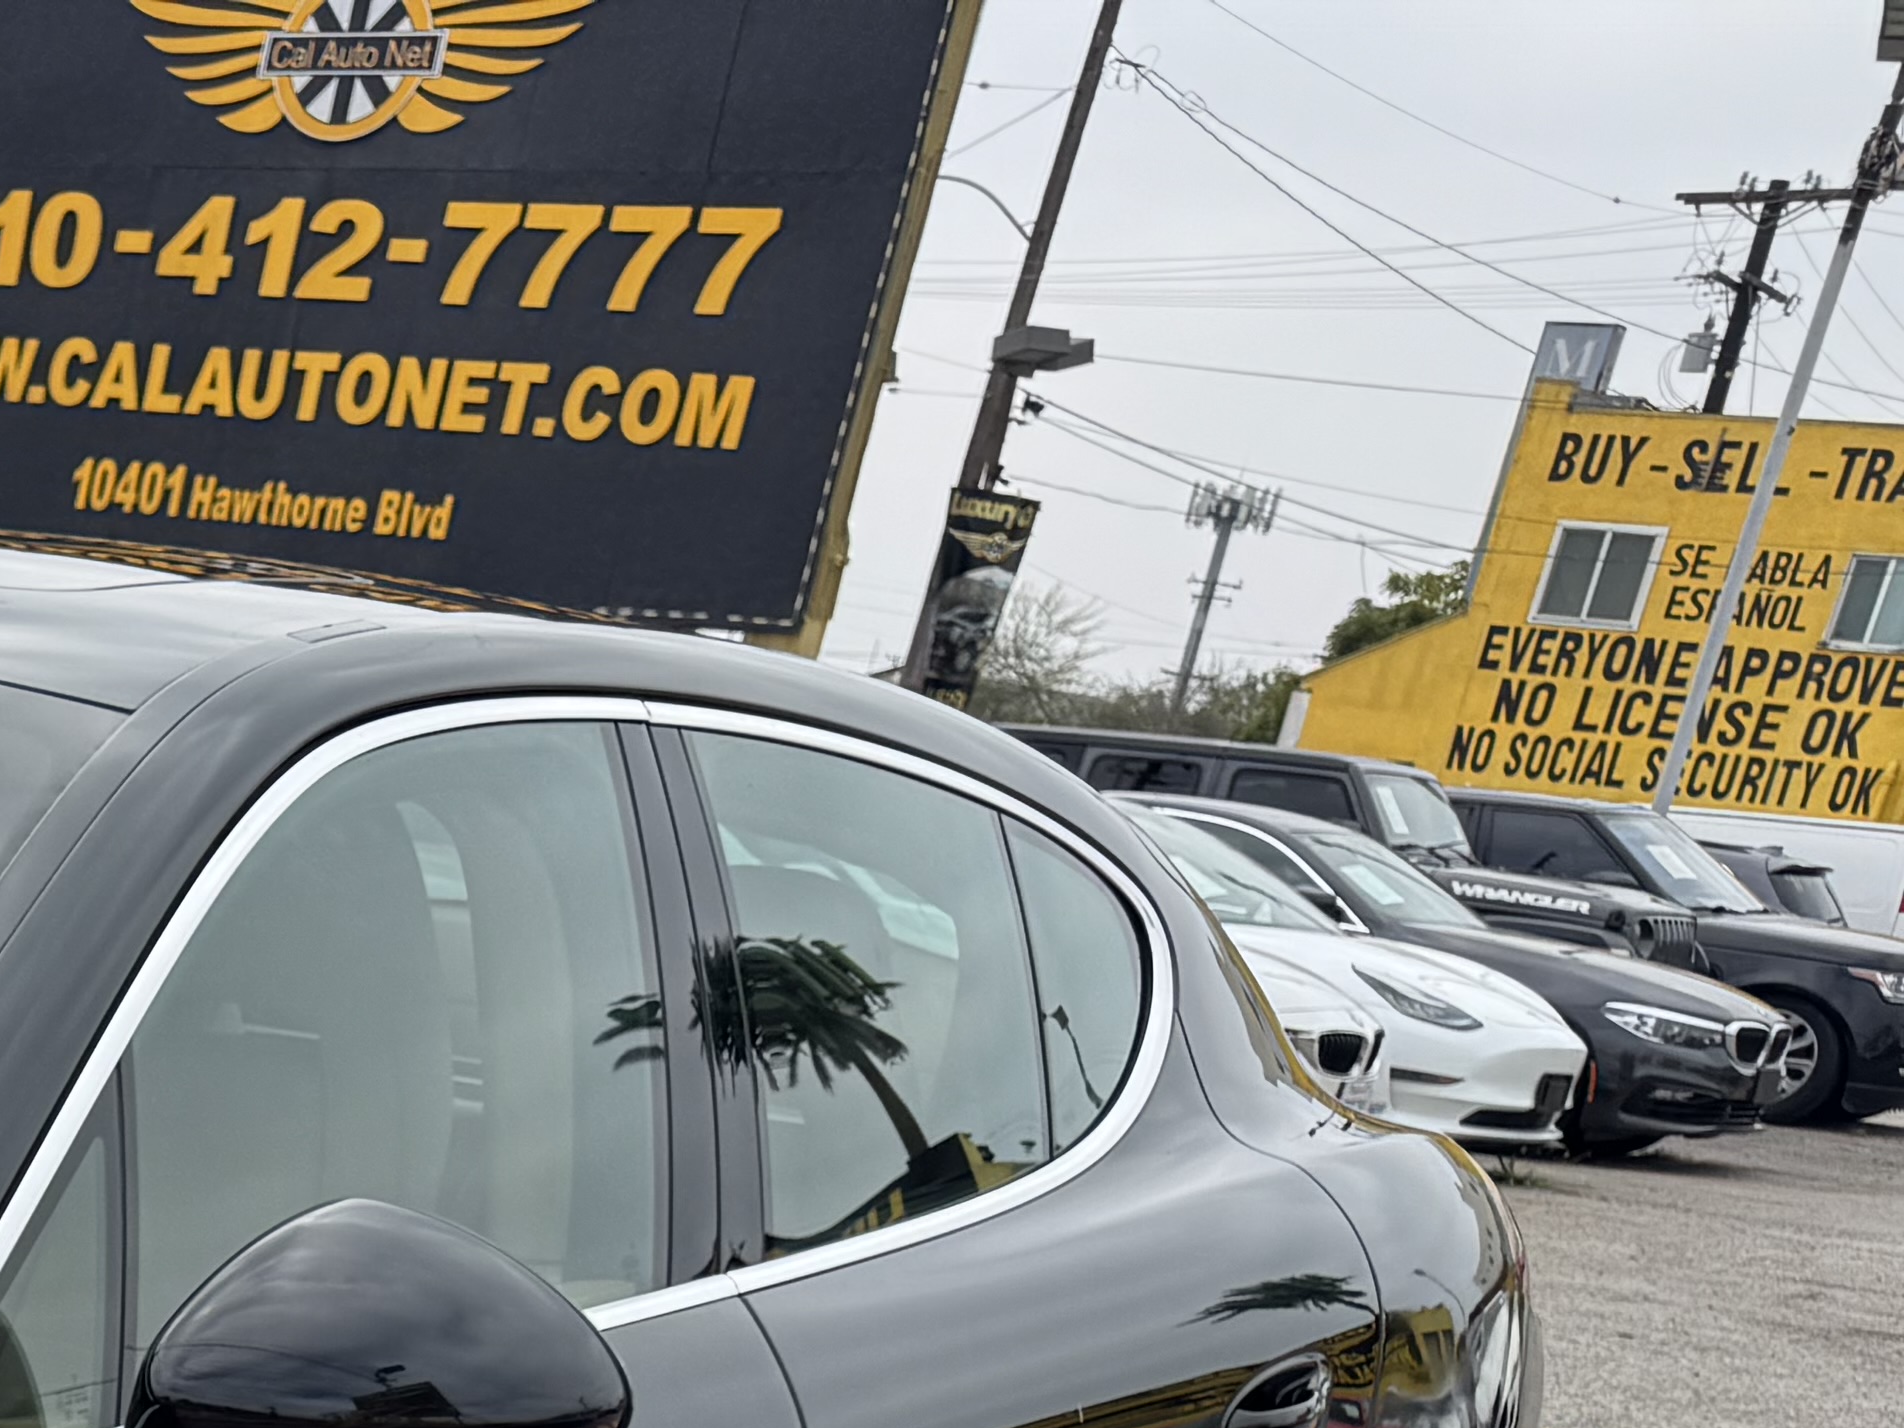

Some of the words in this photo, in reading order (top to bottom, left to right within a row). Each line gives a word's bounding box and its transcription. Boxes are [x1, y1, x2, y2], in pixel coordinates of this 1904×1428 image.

[271, 39, 315, 69] Cal
[317, 38, 380, 69] Auto
[384, 38, 434, 68] Net
[71, 455, 189, 519] 10401
[187, 472, 368, 533] Hawthorne
[373, 488, 455, 541] Blvd
[1668, 543, 1717, 580] SE
[1742, 549, 1833, 590] ABLA
[1477, 624, 1700, 689] EVERYONE
[1710, 644, 1904, 709] APPROVE
[1491, 677, 1558, 727] NO
[1571, 686, 1791, 752] LICENSE
[1800, 707, 1873, 760] OK
[1444, 724, 1497, 774] NO
[1502, 732, 1626, 789] SOCIAL
[1638, 746, 1827, 811] SCURITY
[1826, 764, 1885, 816] OK
[1452, 880, 1591, 915] WRANGLER
